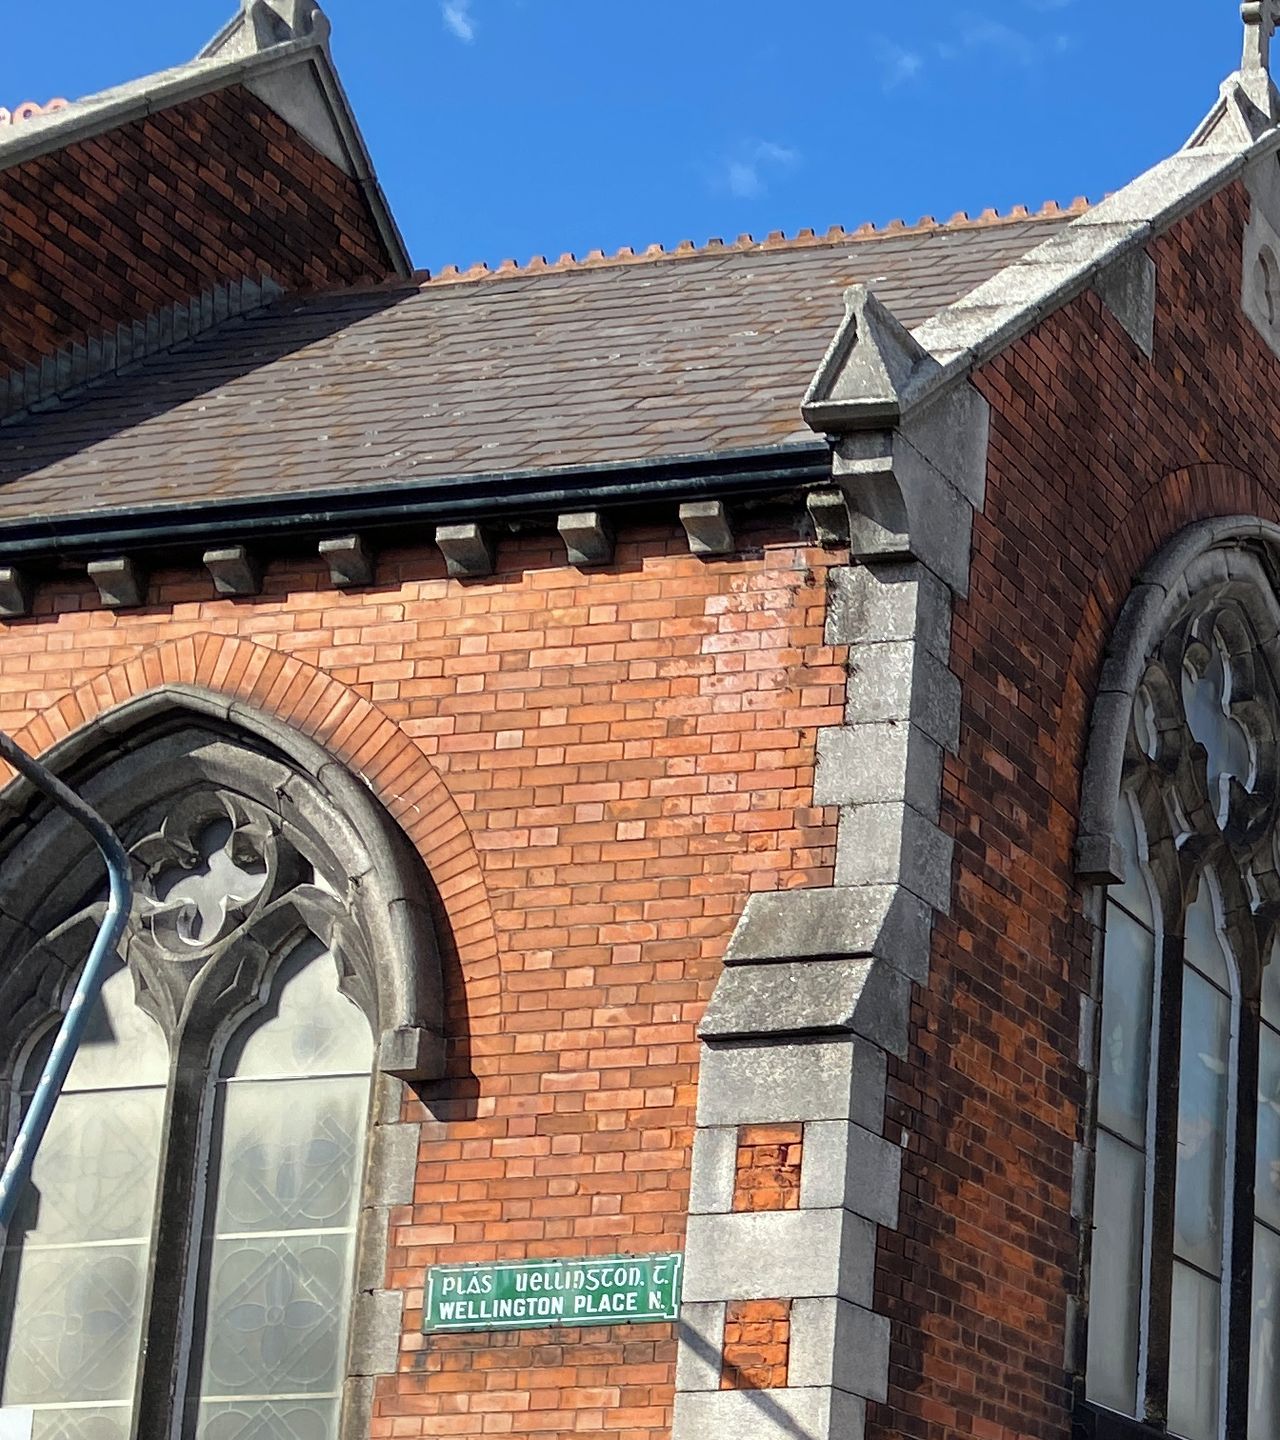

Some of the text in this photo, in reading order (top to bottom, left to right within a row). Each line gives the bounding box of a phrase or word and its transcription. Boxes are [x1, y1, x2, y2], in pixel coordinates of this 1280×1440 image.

[439, 1291, 665, 1320] WELLINGTON PLACE N.
